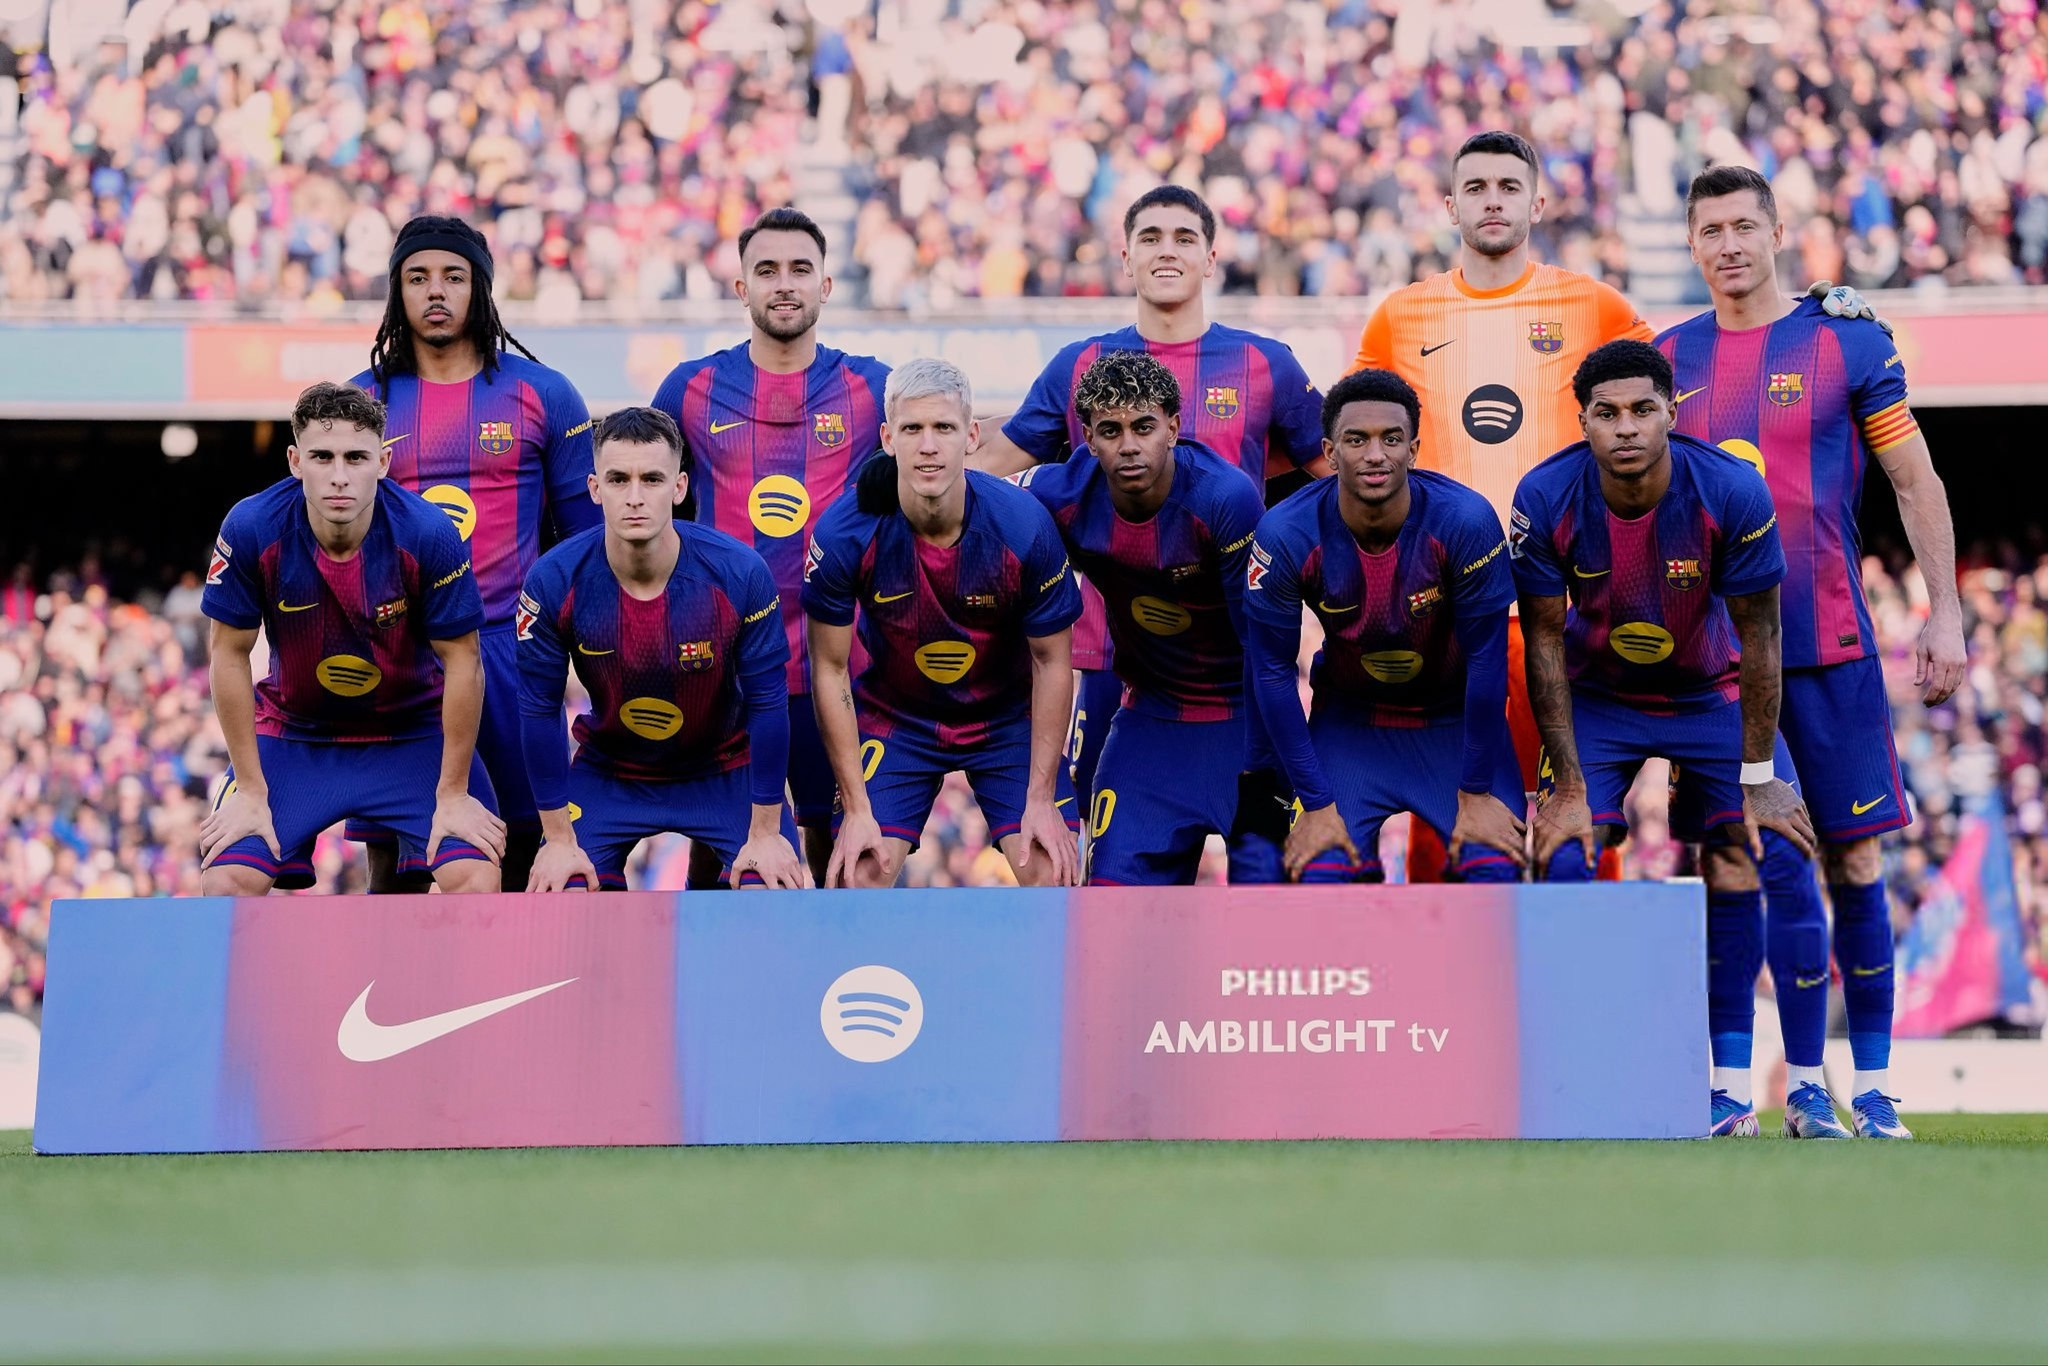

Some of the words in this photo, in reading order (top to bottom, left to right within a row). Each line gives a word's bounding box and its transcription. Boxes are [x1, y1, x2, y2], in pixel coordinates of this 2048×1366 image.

[1090, 788, 1117, 838] 0
[1220, 968, 1371, 996] PHILIPS
[1144, 1019, 1395, 1053] AMBILIGHT
[1407, 1022, 1450, 1052] tv
